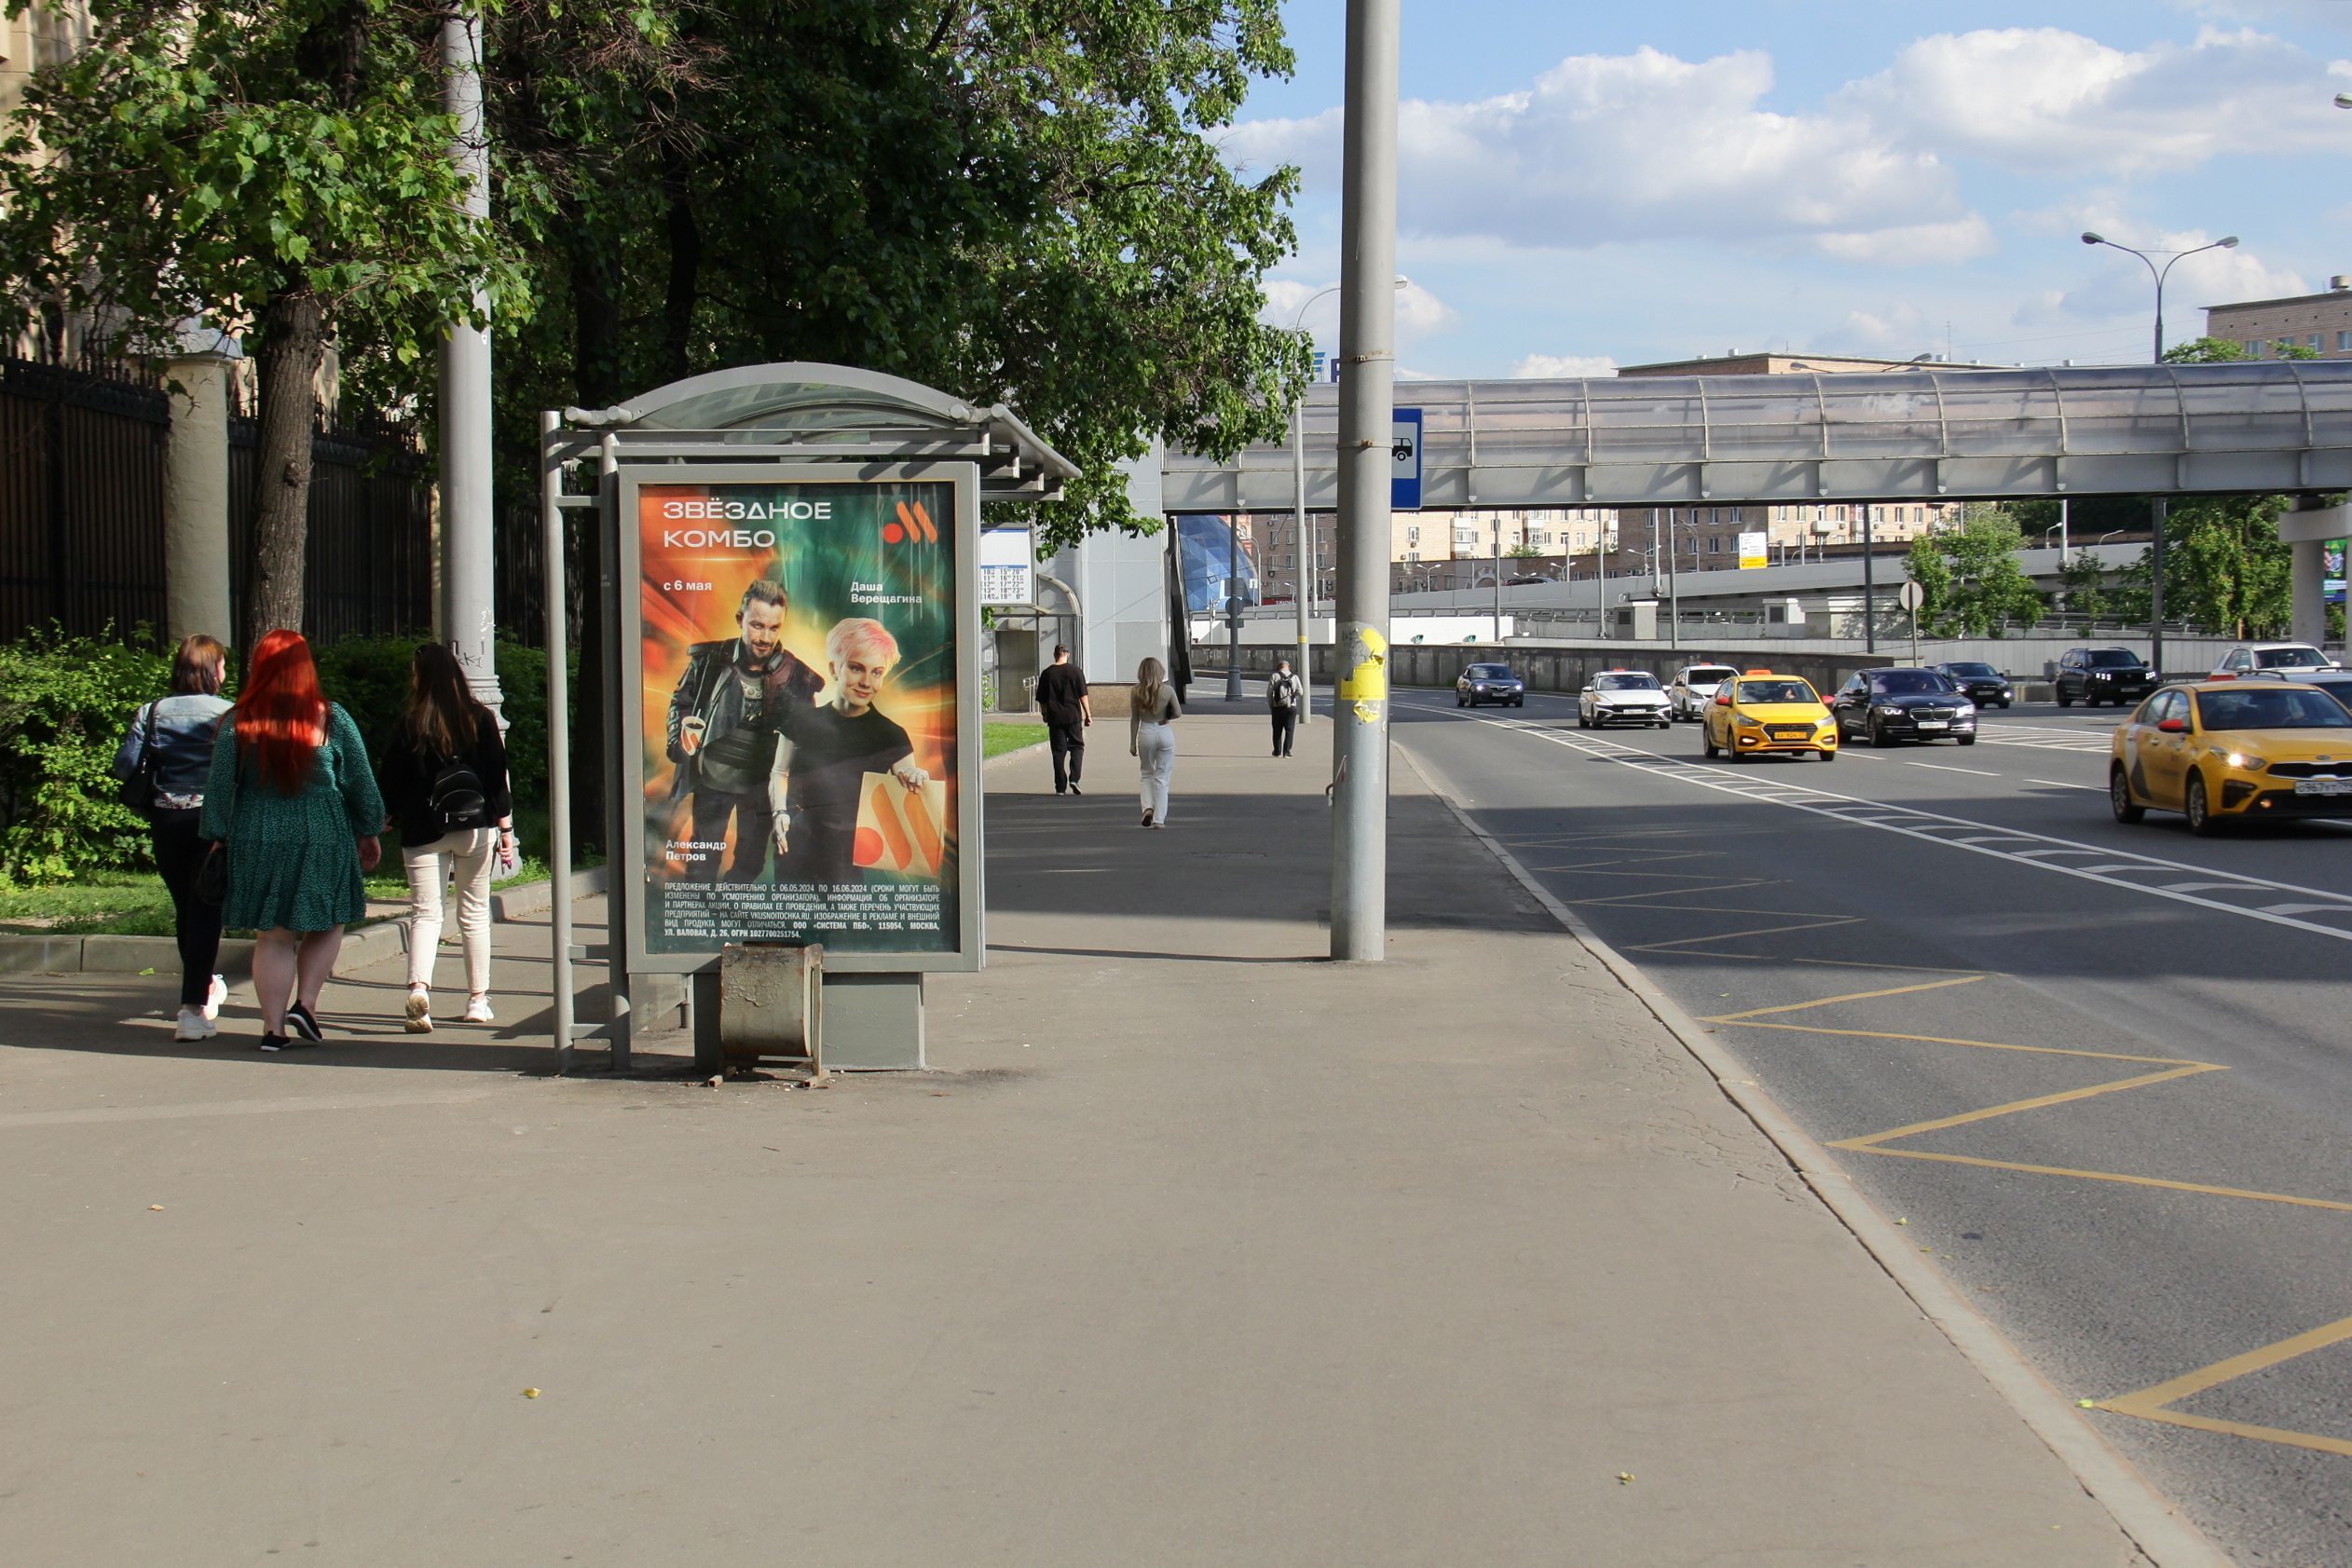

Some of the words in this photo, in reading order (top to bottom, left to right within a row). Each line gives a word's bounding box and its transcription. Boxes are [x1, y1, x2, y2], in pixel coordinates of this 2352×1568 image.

[663, 498, 831, 520] ЗВЁЗДНОЕ
[663, 530, 775, 548] КОМБО
[663, 581, 671, 591] с
[674, 579, 682, 591] 6
[686, 581, 712, 591] мая
[851, 582, 883, 593] Даша
[851, 593, 923, 606] Верещагина
[665, 839, 727, 851] Александр
[665, 851, 706, 862] Петров
[664, 882, 711, 891] ПРЕДЛОЖЕНИЕ
[715, 881, 767, 893] ДЕЙСТВИТЕЛЬНО
[779, 884, 814, 893] 06.05.2024
[870, 884, 895, 893] (СРОКИ
[721, 893, 764, 901] УСМОТРЕНИЮ
[786, 904, 827, 912] ПРОВЕДЕНИЯ,
[894, 904, 939, 912] УЧАСТВУЮЩИХ
[665, 909, 710, 918] ПРЕДПРИЯТИЙ
[908, 911, 939, 920] ВНЕШНИЙ
[665, 920, 678, 928] ВИД
[878, 922, 904, 931] 115054,
[909, 922, 939, 931] МОСКВА,
